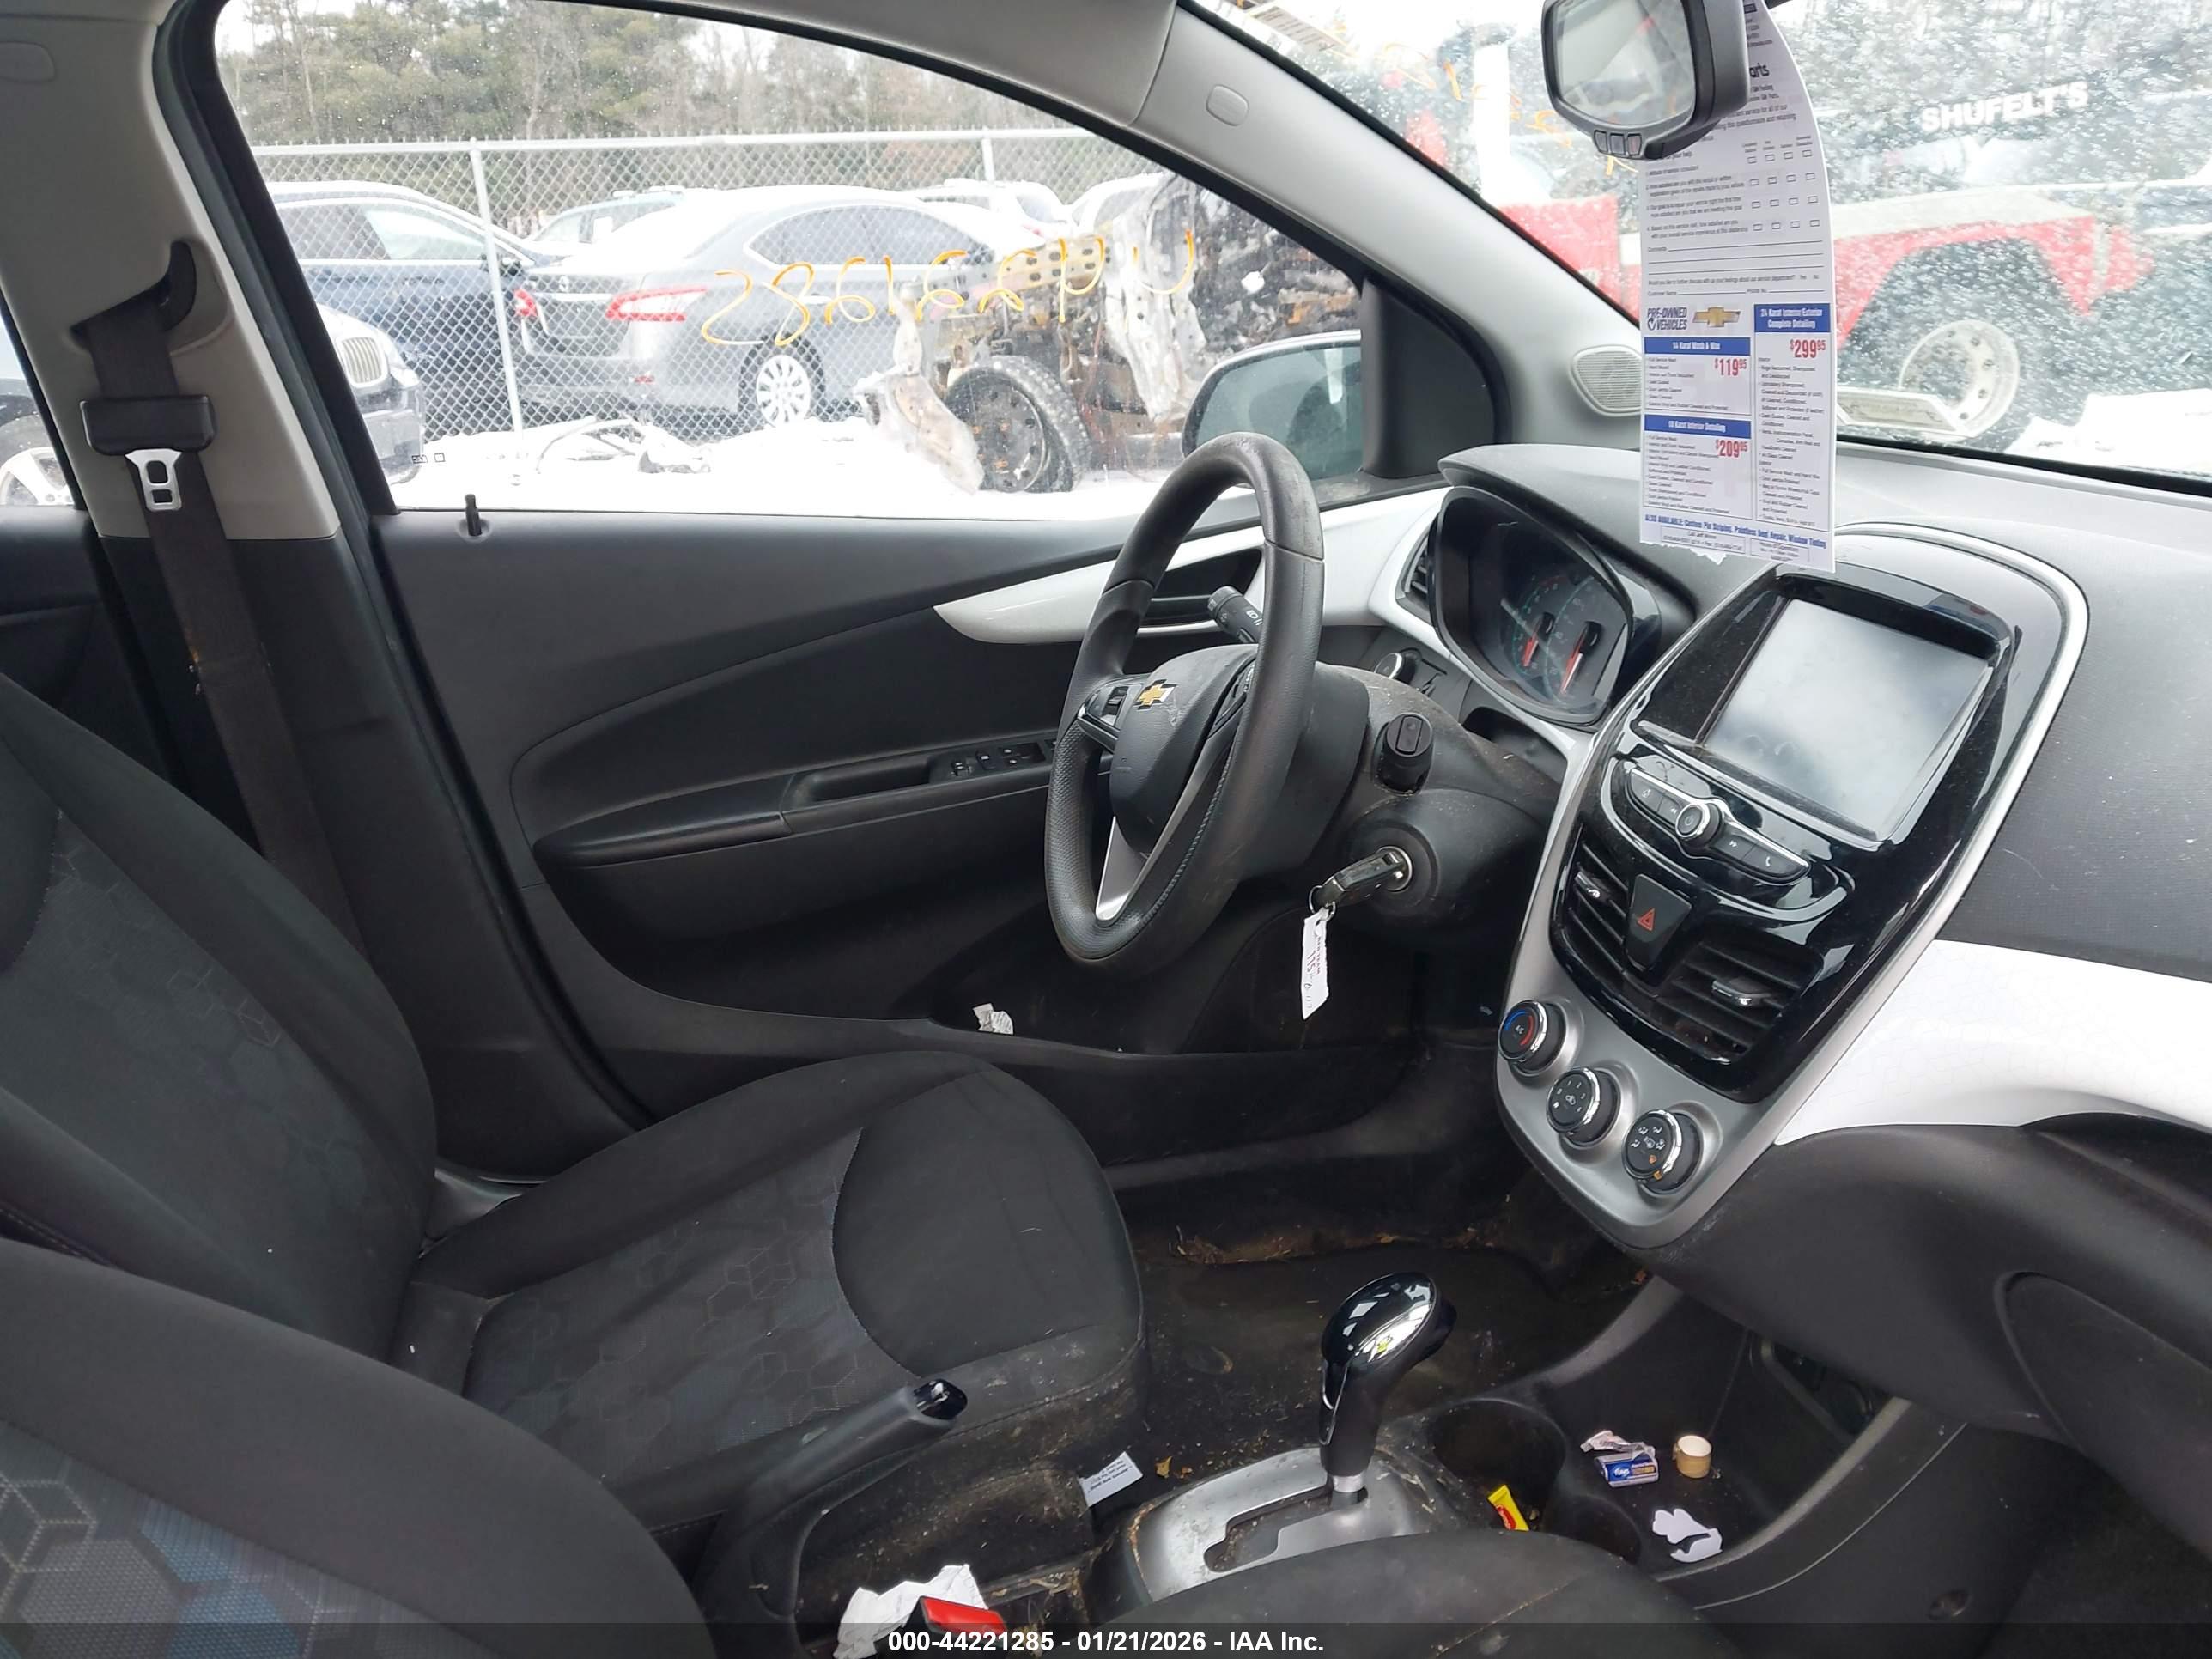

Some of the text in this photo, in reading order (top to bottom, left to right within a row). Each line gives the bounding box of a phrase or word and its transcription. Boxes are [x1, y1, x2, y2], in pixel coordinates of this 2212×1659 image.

[1922, 81, 2088, 130] SHUFELT'S
[1647, 307, 1687, 318] PRE-OWNED
[1656, 319, 1687, 331] VEHICLES
